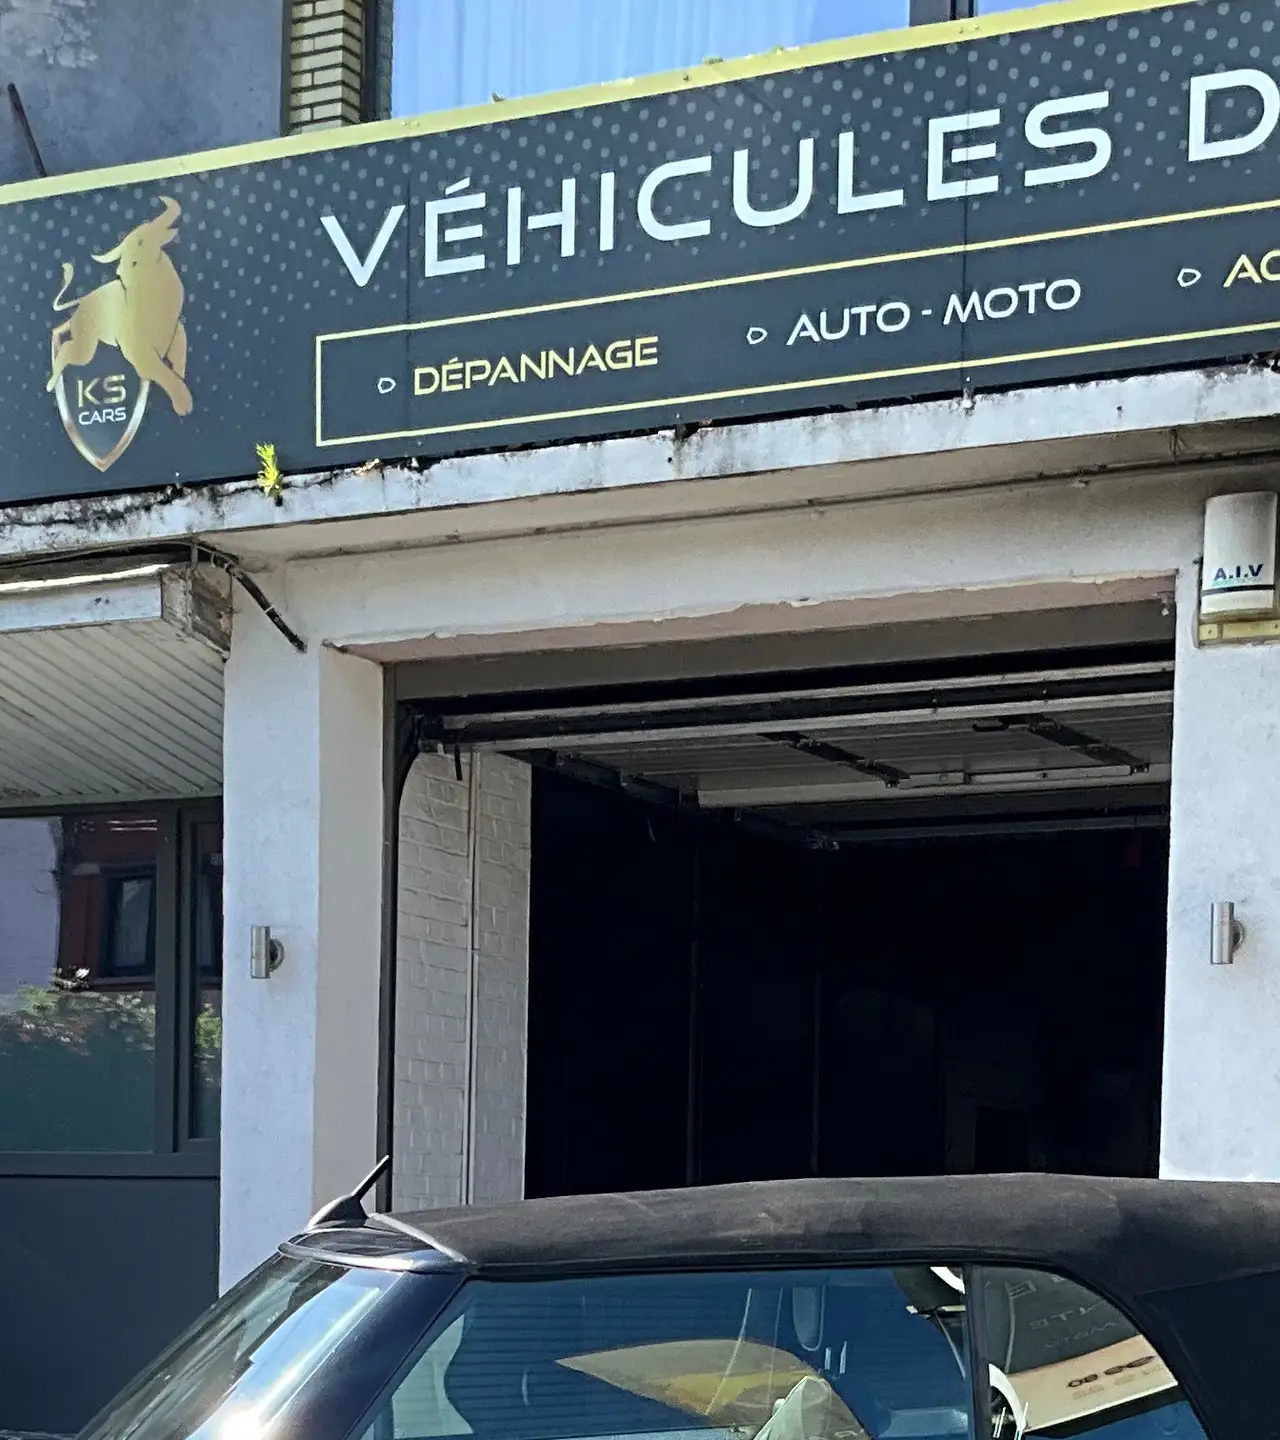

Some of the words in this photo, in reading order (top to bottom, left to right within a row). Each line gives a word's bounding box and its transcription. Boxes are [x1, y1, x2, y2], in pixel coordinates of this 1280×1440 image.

[320, 90, 1113, 288] VÉHICULES
[786, 301, 911, 346] AUTO
[943, 278, 1081, 325] MOTO
[77, 374, 126, 408] KS
[414, 336, 659, 395] DÉPANNAGE
[78, 407, 126, 425] CARS
